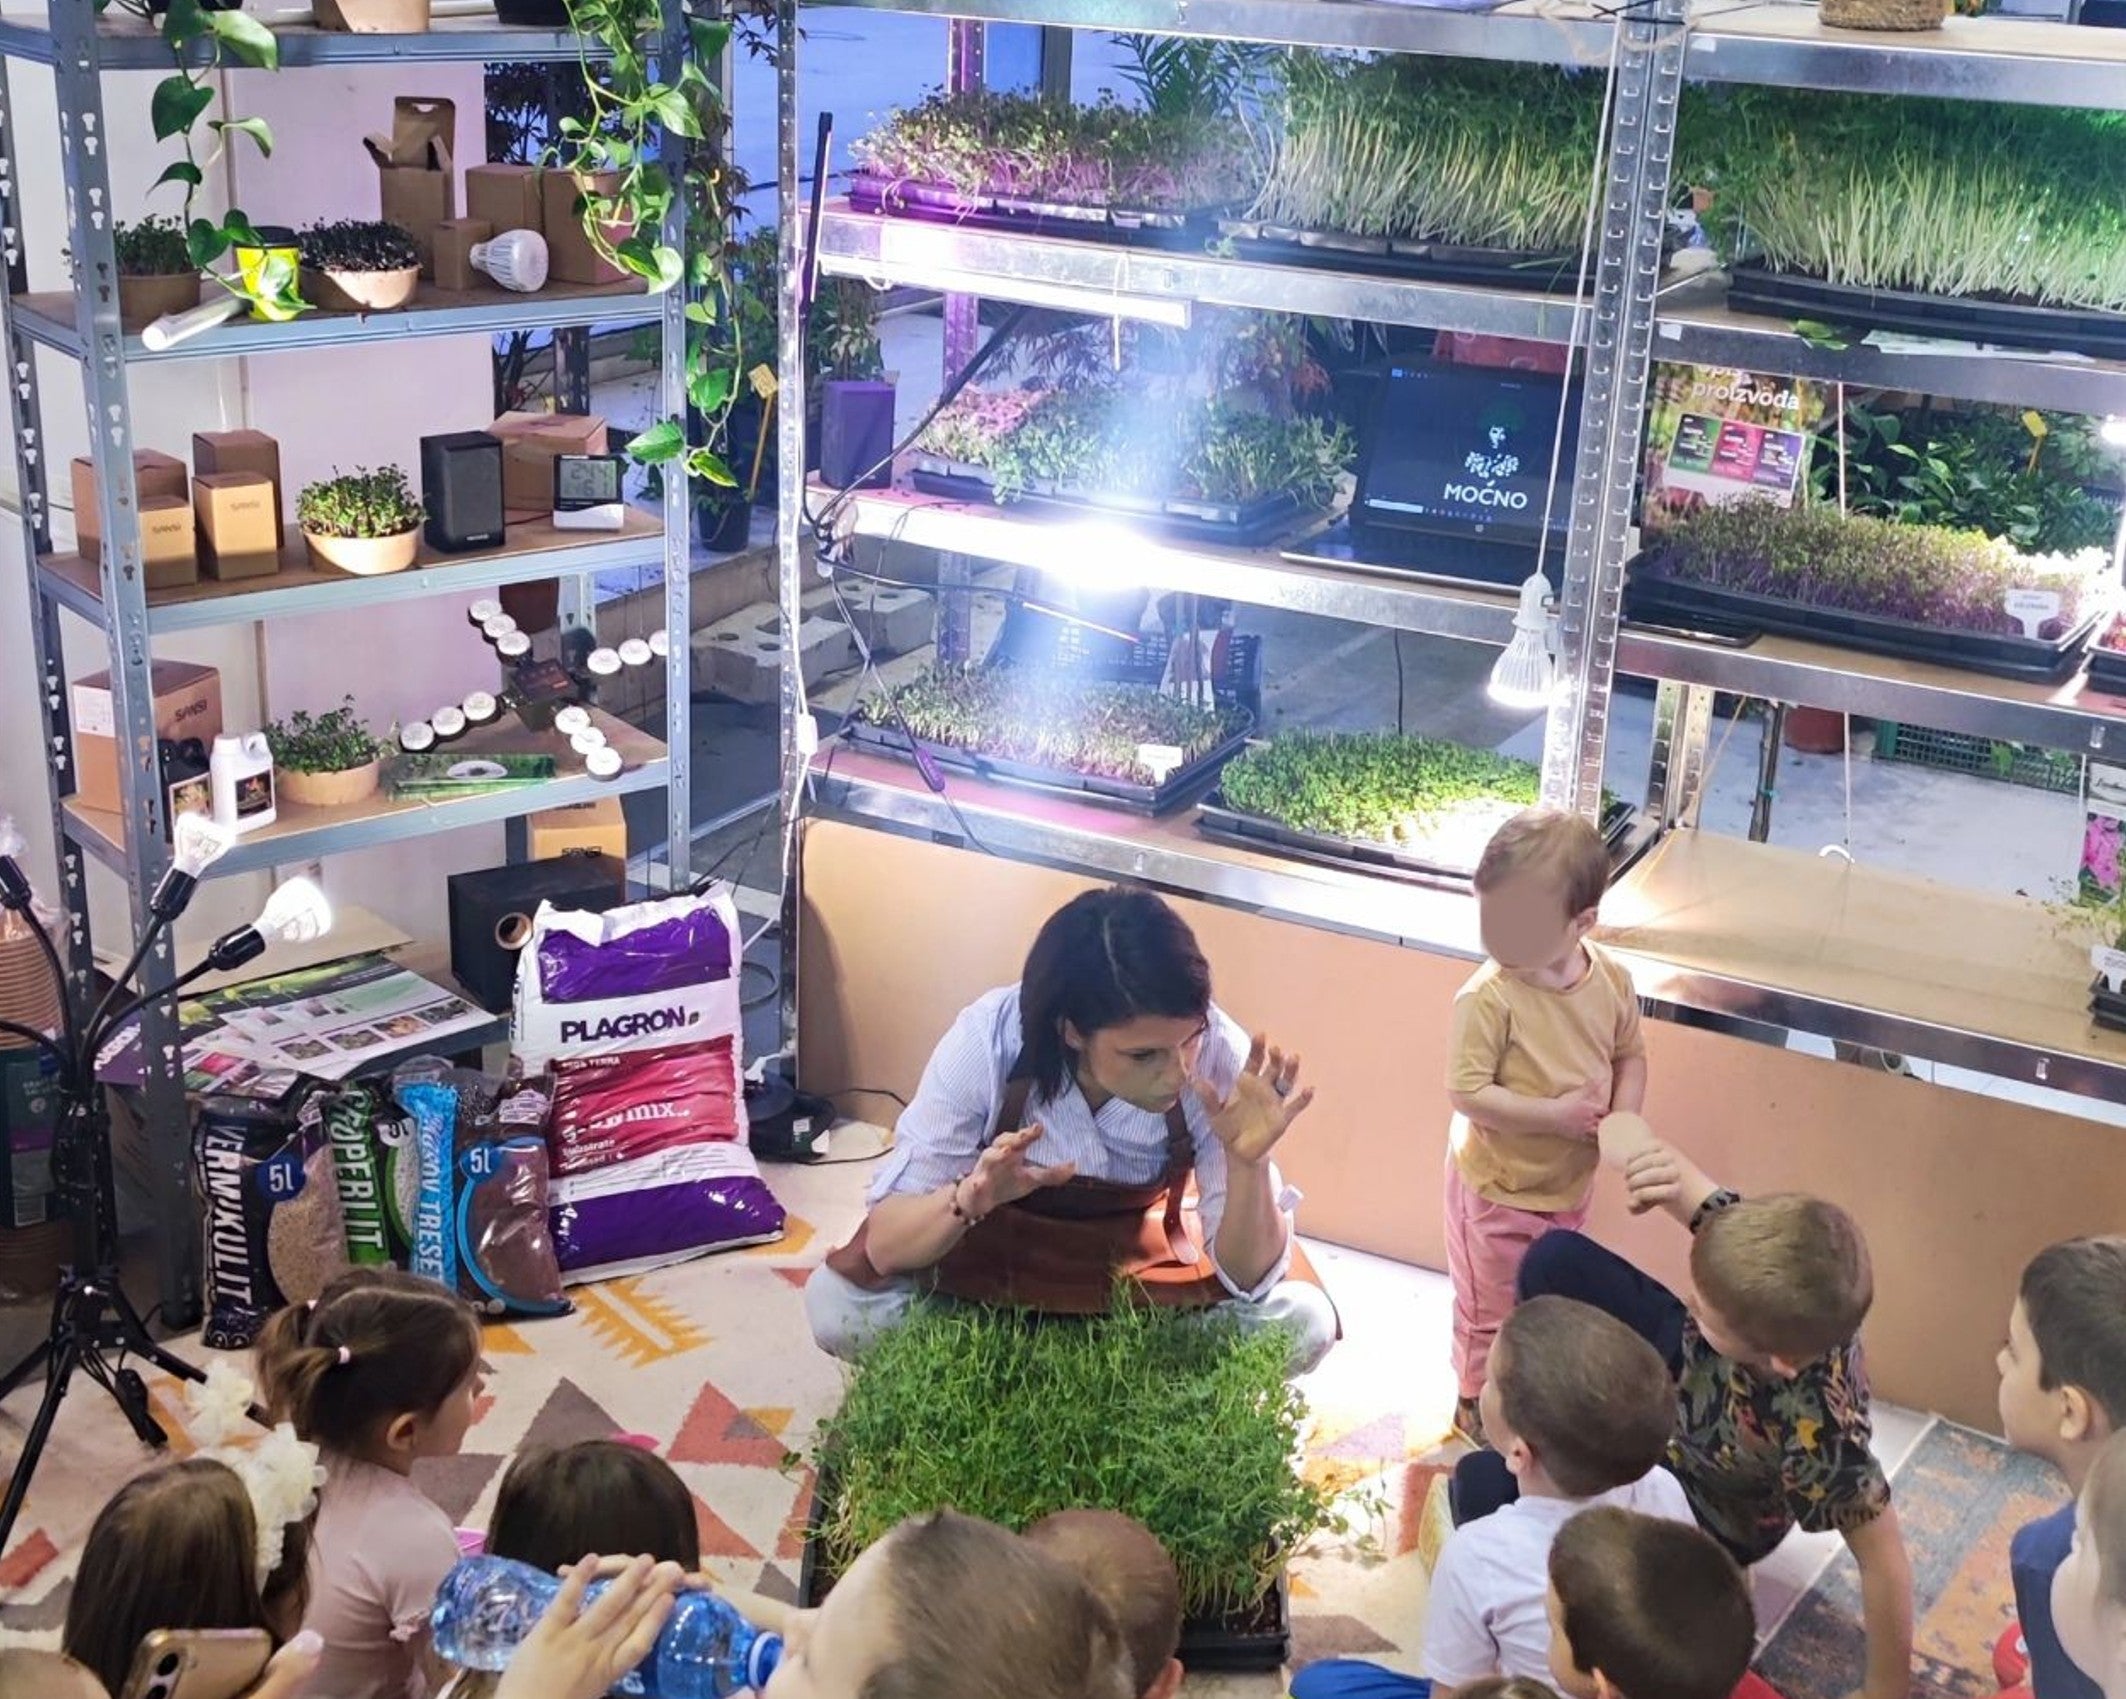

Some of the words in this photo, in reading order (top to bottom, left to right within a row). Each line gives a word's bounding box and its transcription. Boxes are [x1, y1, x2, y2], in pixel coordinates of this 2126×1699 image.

[1692, 382, 1800, 410] proizvoda
[1443, 479, 1528, 510] MOĆNO
[175, 699, 207, 722] SANSI
[561, 1006, 685, 1043] PLAGRON
[205, 1125, 252, 1305] VERMIKULIT
